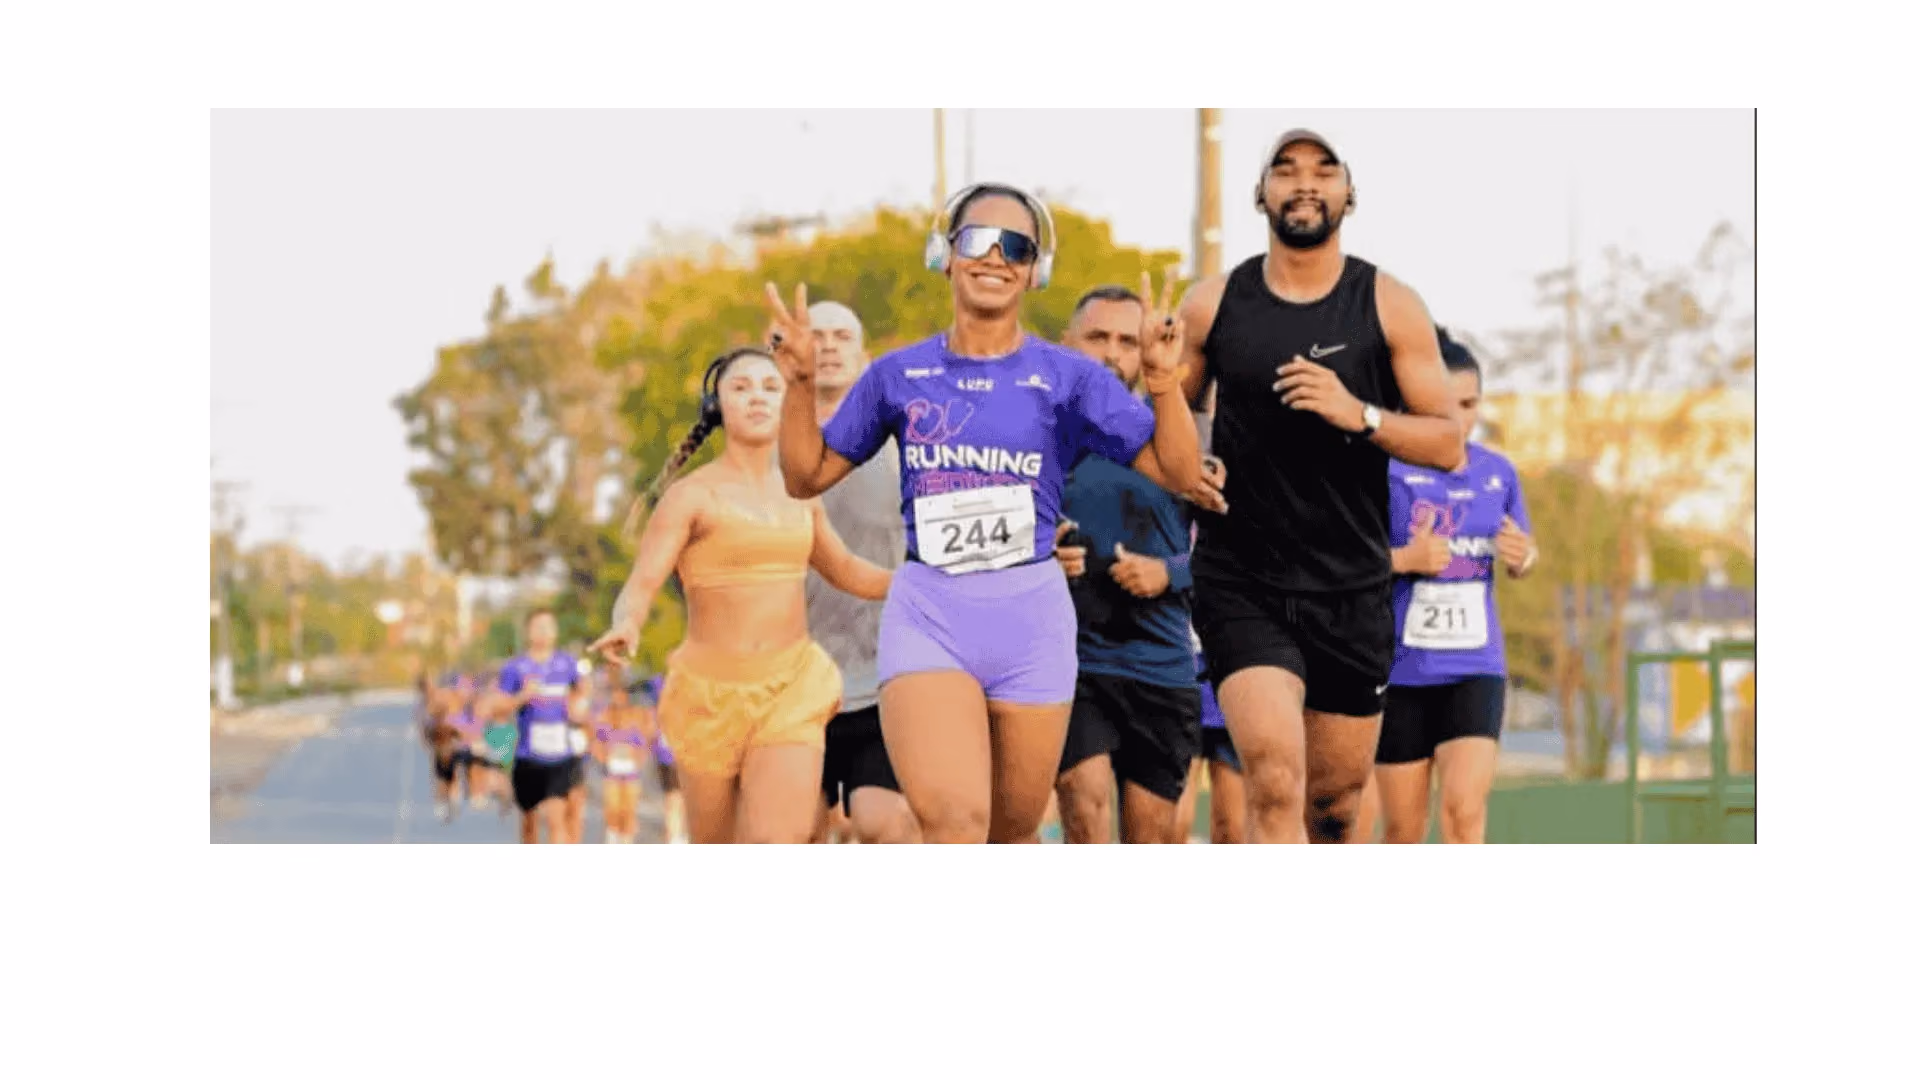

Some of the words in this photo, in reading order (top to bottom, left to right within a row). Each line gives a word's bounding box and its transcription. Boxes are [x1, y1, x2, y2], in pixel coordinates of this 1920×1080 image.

[905, 444, 1042, 477] RUNNING
[941, 516, 1012, 554] 244
[1423, 605, 1468, 629] 211
